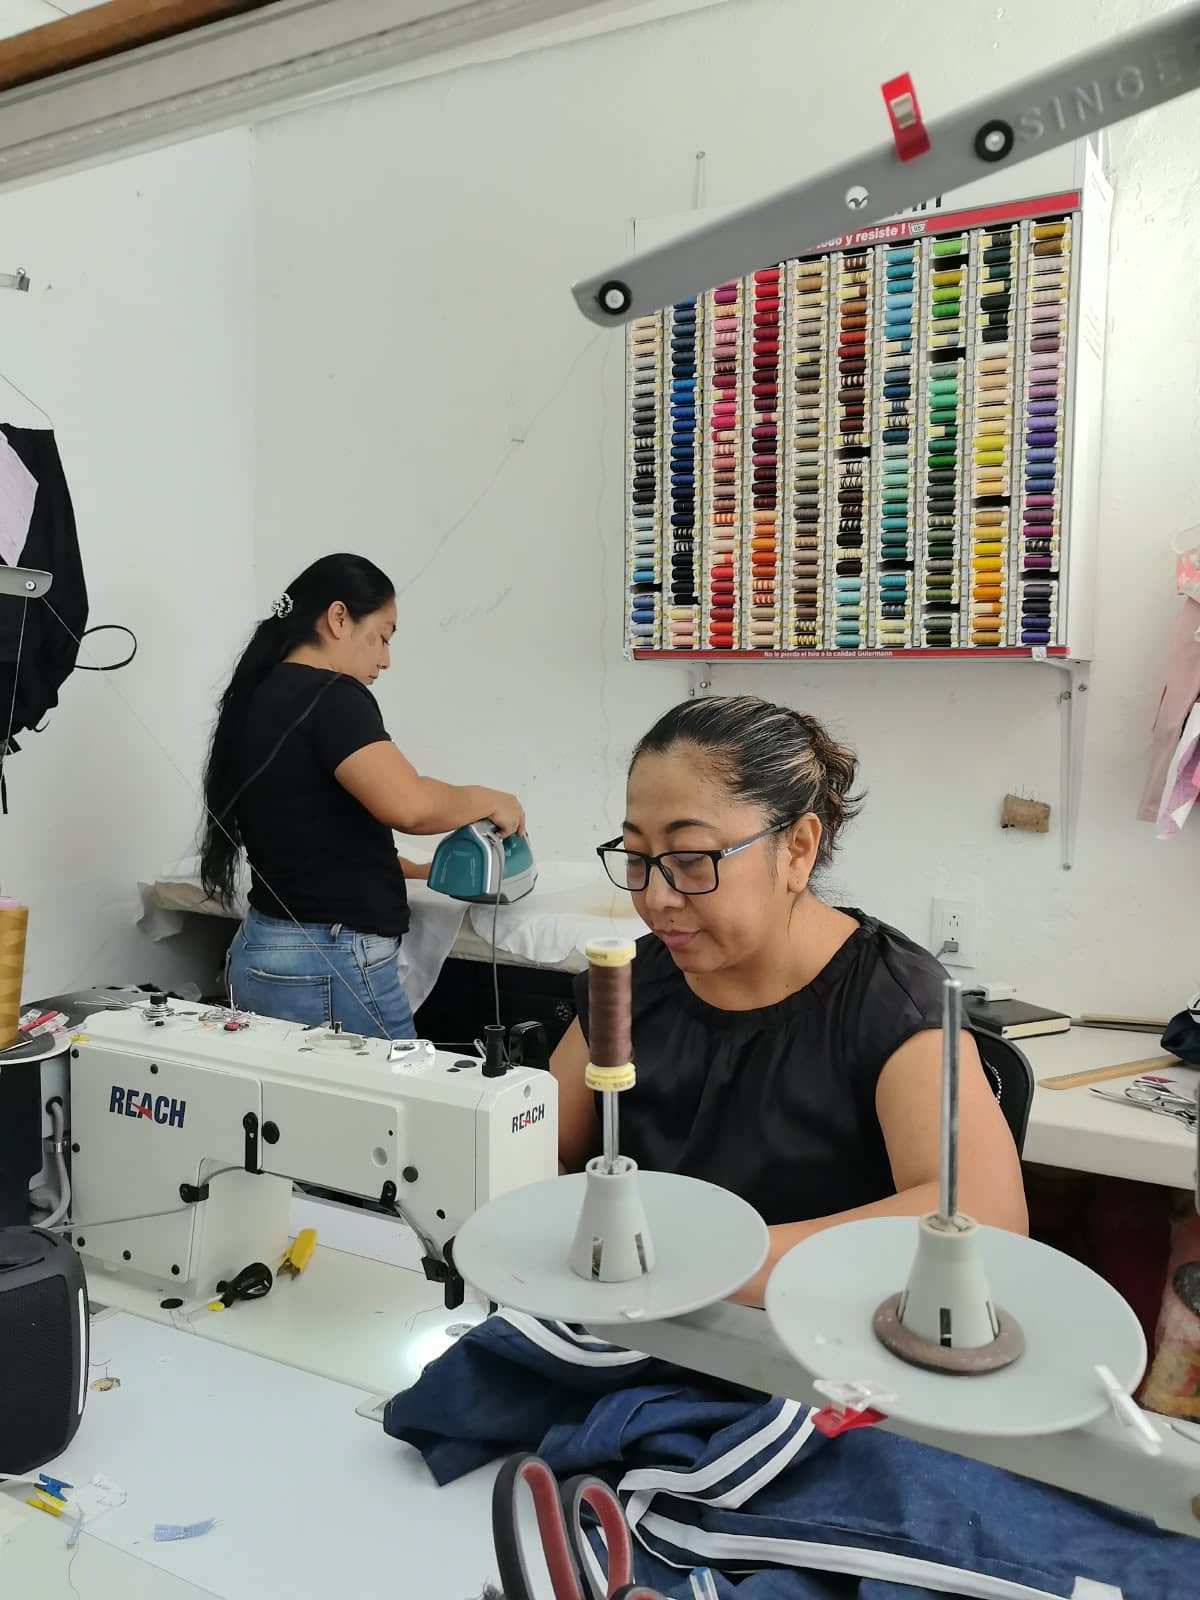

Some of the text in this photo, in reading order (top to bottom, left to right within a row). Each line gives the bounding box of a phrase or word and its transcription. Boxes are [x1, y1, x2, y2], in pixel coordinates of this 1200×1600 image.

[845, 234, 853, 246] y
[855, 226, 898, 242] resiste
[109, 1085, 186, 1128] REACH
[511, 1103, 545, 1133] REACH
